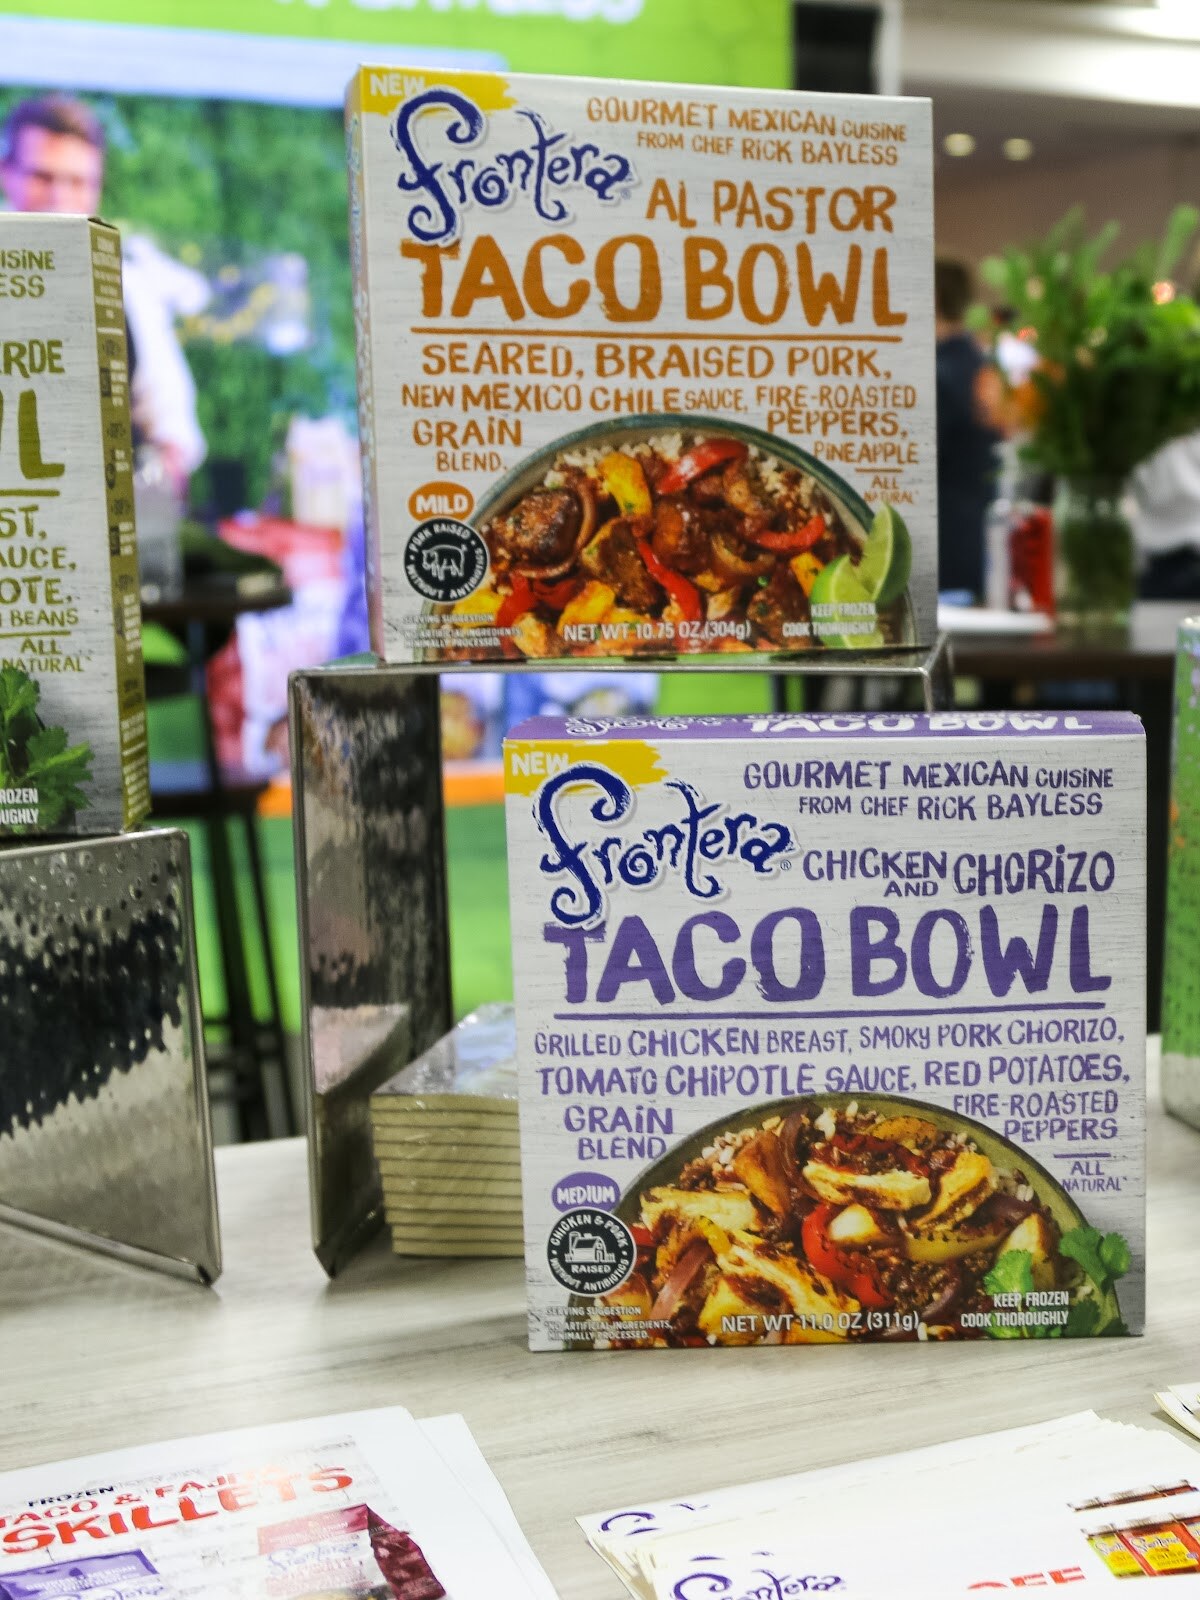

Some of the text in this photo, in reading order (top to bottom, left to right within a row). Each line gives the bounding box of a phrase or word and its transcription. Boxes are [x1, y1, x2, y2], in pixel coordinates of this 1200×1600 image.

[370, 73, 426, 97] NEW
[587, 97, 907, 141] GOURMET MEXICAN CUISINE
[636, 131, 898, 165] FROM CHEF RICK BAYLESS
[645, 178, 896, 234] AL PASTOR
[401, 234, 908, 327] TACO BOWL
[421, 343, 892, 379] SEARED, BRAISED PORK,
[402, 384, 916, 413] NEW MEXICO CHILE SAUCE, FIRE-ROASTED
[413, 419, 522, 446] GRAIN
[767, 411, 909, 437] PEPPERS,
[815, 443, 919, 465] PINEAPPLE
[415, 495, 469, 514] MILD
[563, 622, 674, 641] NET WT 10.75
[510, 752, 569, 776] NEW
[743, 761, 1113, 789] GOURMET MEXICAN CUISINE
[799, 792, 1103, 821] FROM CHEF RICK BAYLESS
[803, 844, 1115, 897] CHICKEN AND CHORIZO
[543, 905, 1112, 1005] TACO BOWL
[534, 1017, 1126, 1057] GRILLED CHICKEN BREAST, SMOKY PORK CHORIZO,
[539, 1053, 1131, 1098] TOMATO CHIPOTLE SAUCE, RED POTATOES,
[954, 1090, 1117, 1117] FIRE-ROASTED
[563, 1106, 674, 1134] GRAIN
[1005, 1118, 1117, 1142] PEPPERS
[578, 1137, 666, 1160] BLEND
[1070, 1161, 1104, 1176] ALL
[556, 1186, 615, 1205] MEDIUM
[551, 1215, 591, 1246] CHICKEN
[604, 1218, 628, 1248] PORK
[571, 1265, 610, 1273] RAISED
[993, 1292, 1069, 1307] KEEP FROZEN
[721, 1311, 919, 1333] NET WT 11.0 OZ (311g)
[960, 1311, 1069, 1327] COOK THOROUGHLY
[28, 1485, 115, 1507] FROZEN
[2, 1466, 354, 1555] SKILLETS
